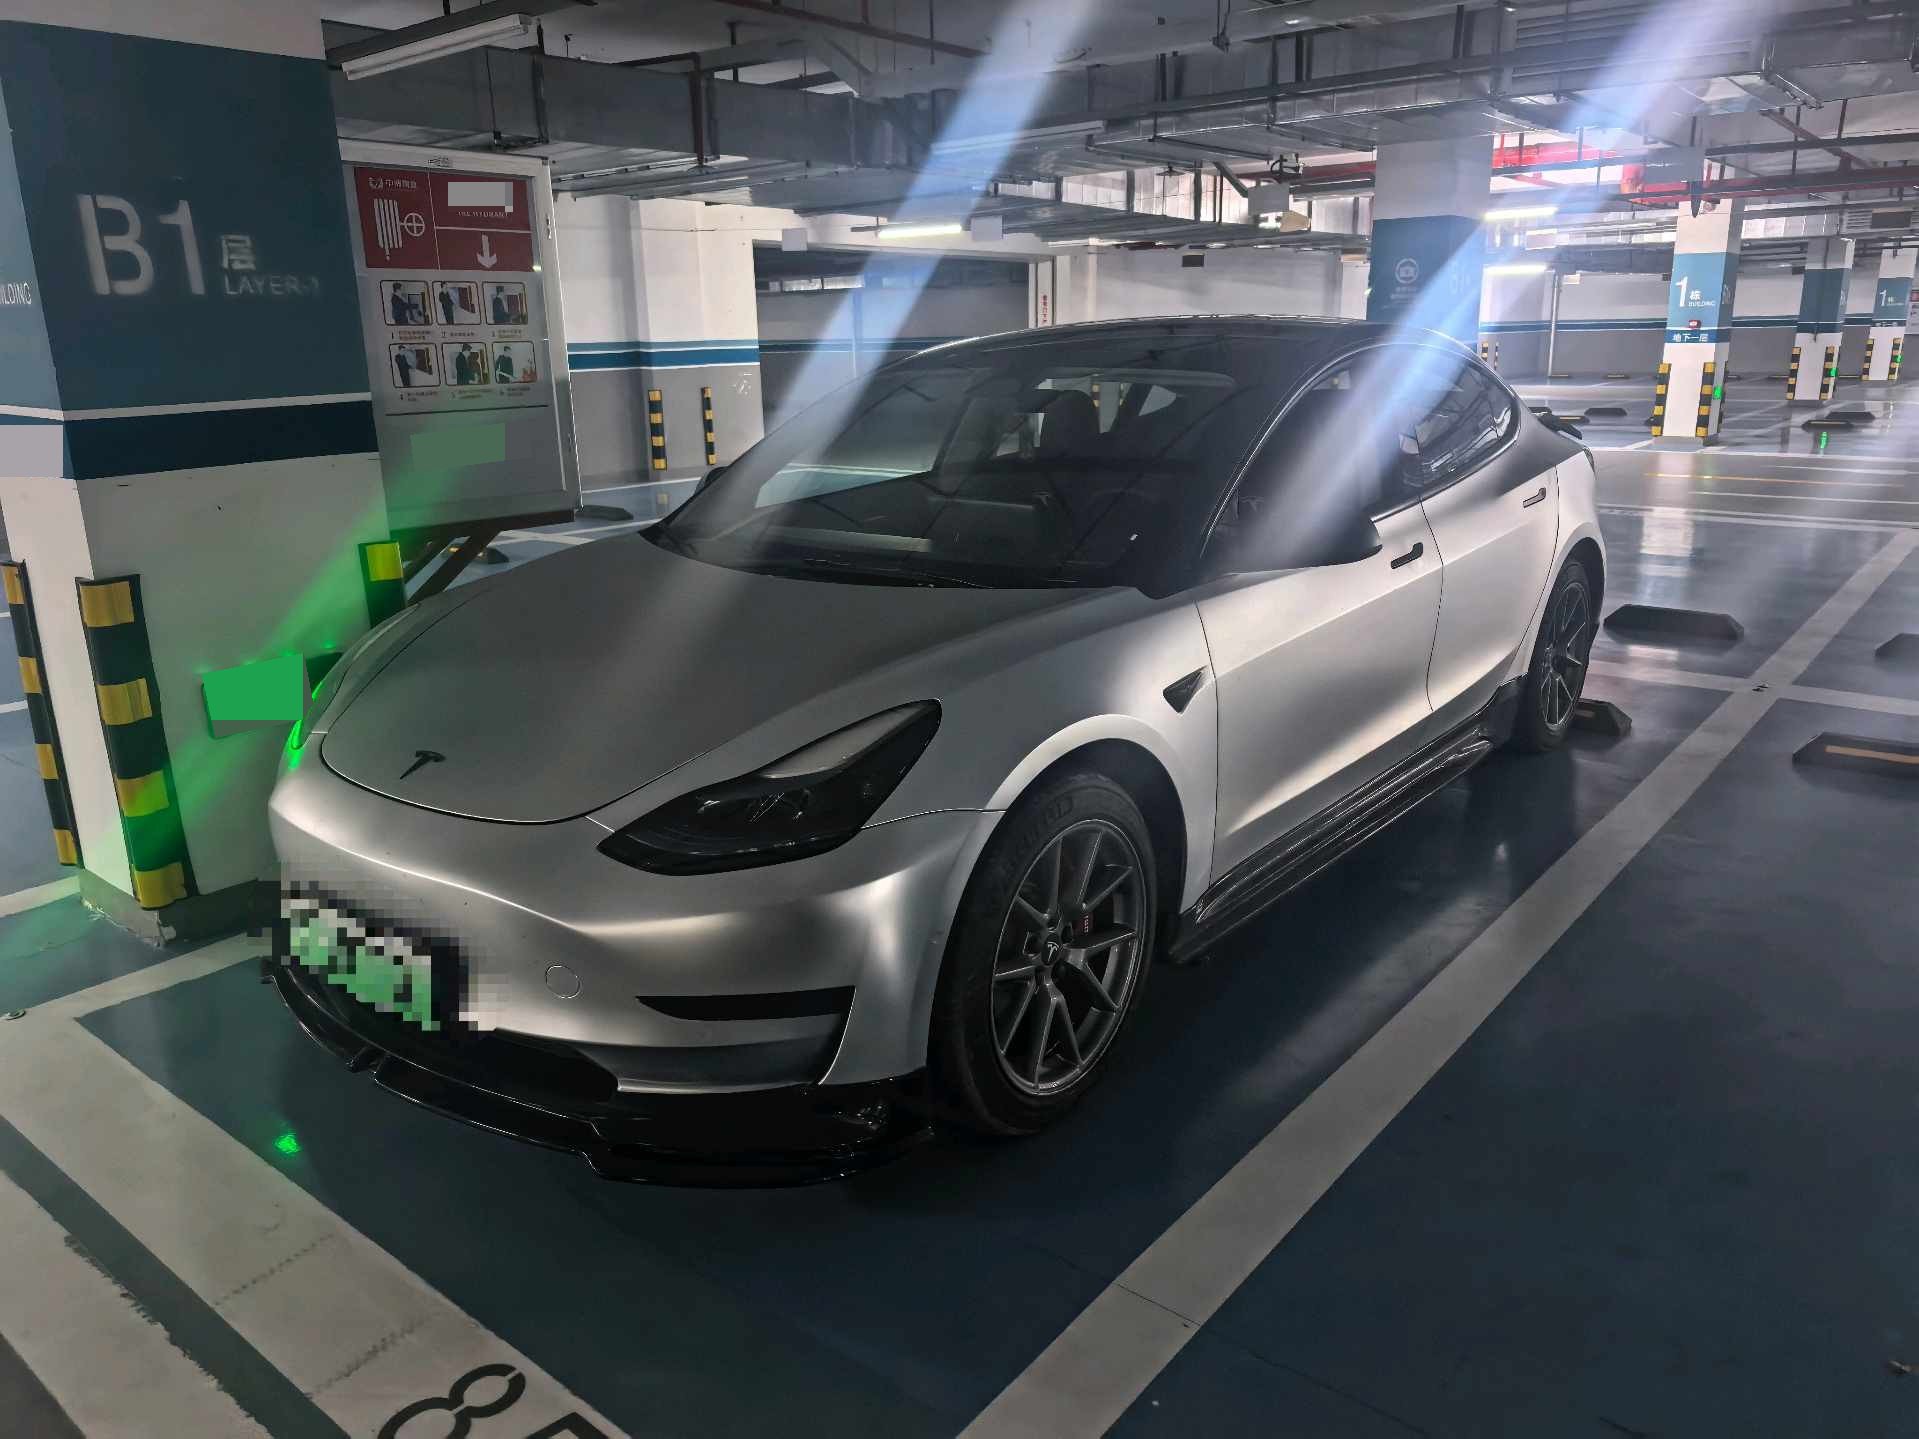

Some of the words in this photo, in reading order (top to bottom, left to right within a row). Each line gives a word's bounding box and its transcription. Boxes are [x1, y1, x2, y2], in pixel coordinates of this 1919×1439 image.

[77, 193, 206, 296] B1
[220, 233, 257, 271] 层
[0, 281, 33, 305] ILDING
[1674, 276, 1689, 308] 1
[376, 1363, 609, 1439] 8
